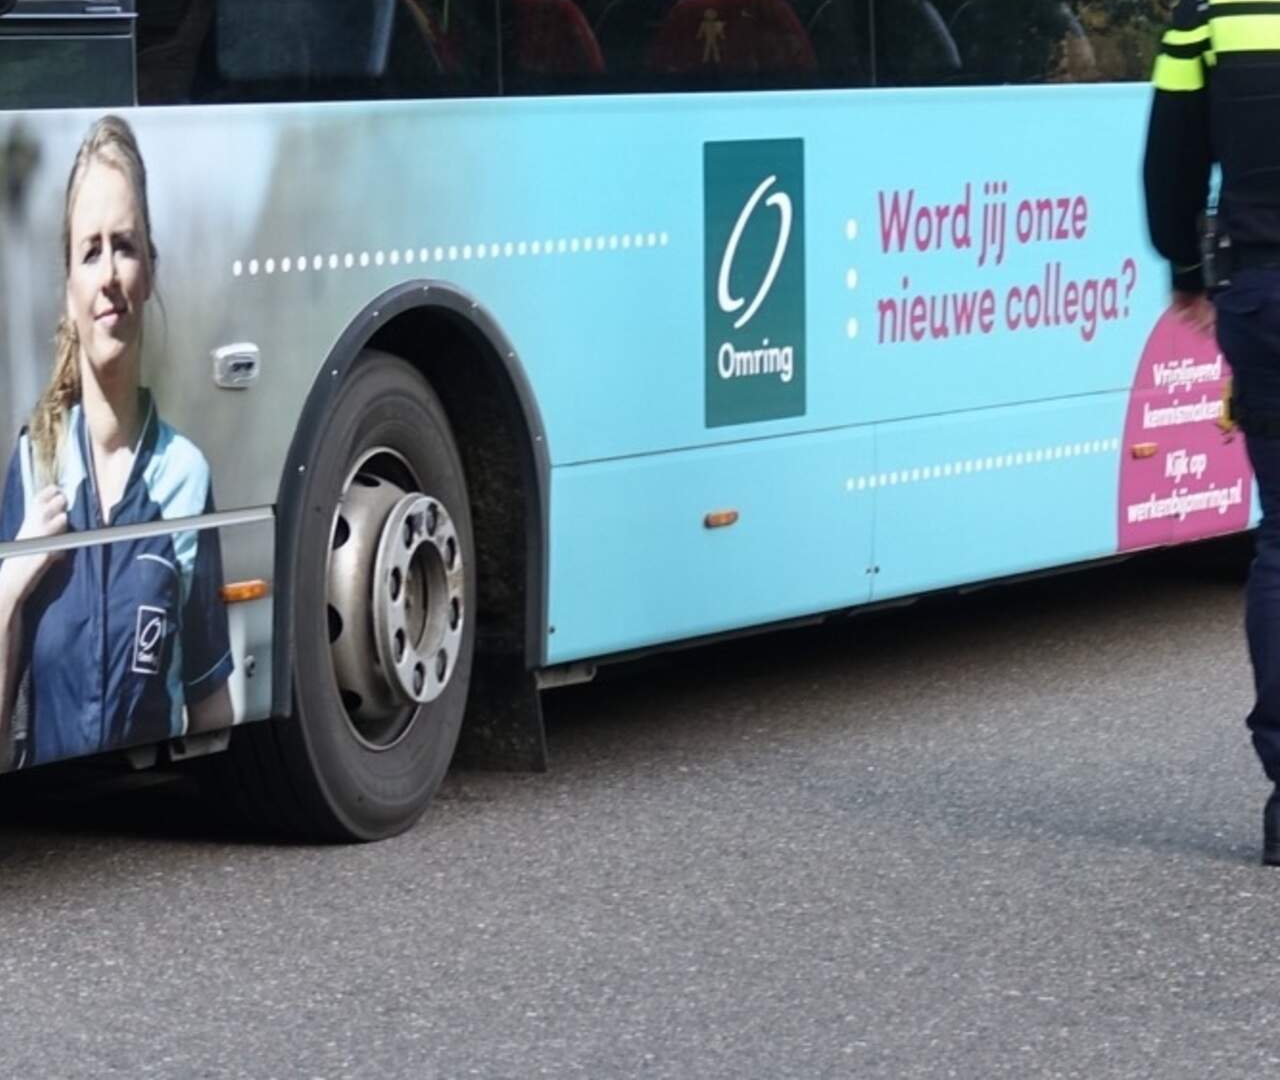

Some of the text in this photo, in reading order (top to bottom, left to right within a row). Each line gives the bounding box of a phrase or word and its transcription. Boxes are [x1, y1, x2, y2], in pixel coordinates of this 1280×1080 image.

[877, 181, 1088, 266] Word jij onze
[877, 258, 1137, 344] nieuwe collega?
[718, 340, 793, 382] Omring
[1165, 449, 1207, 483] Kijk op
